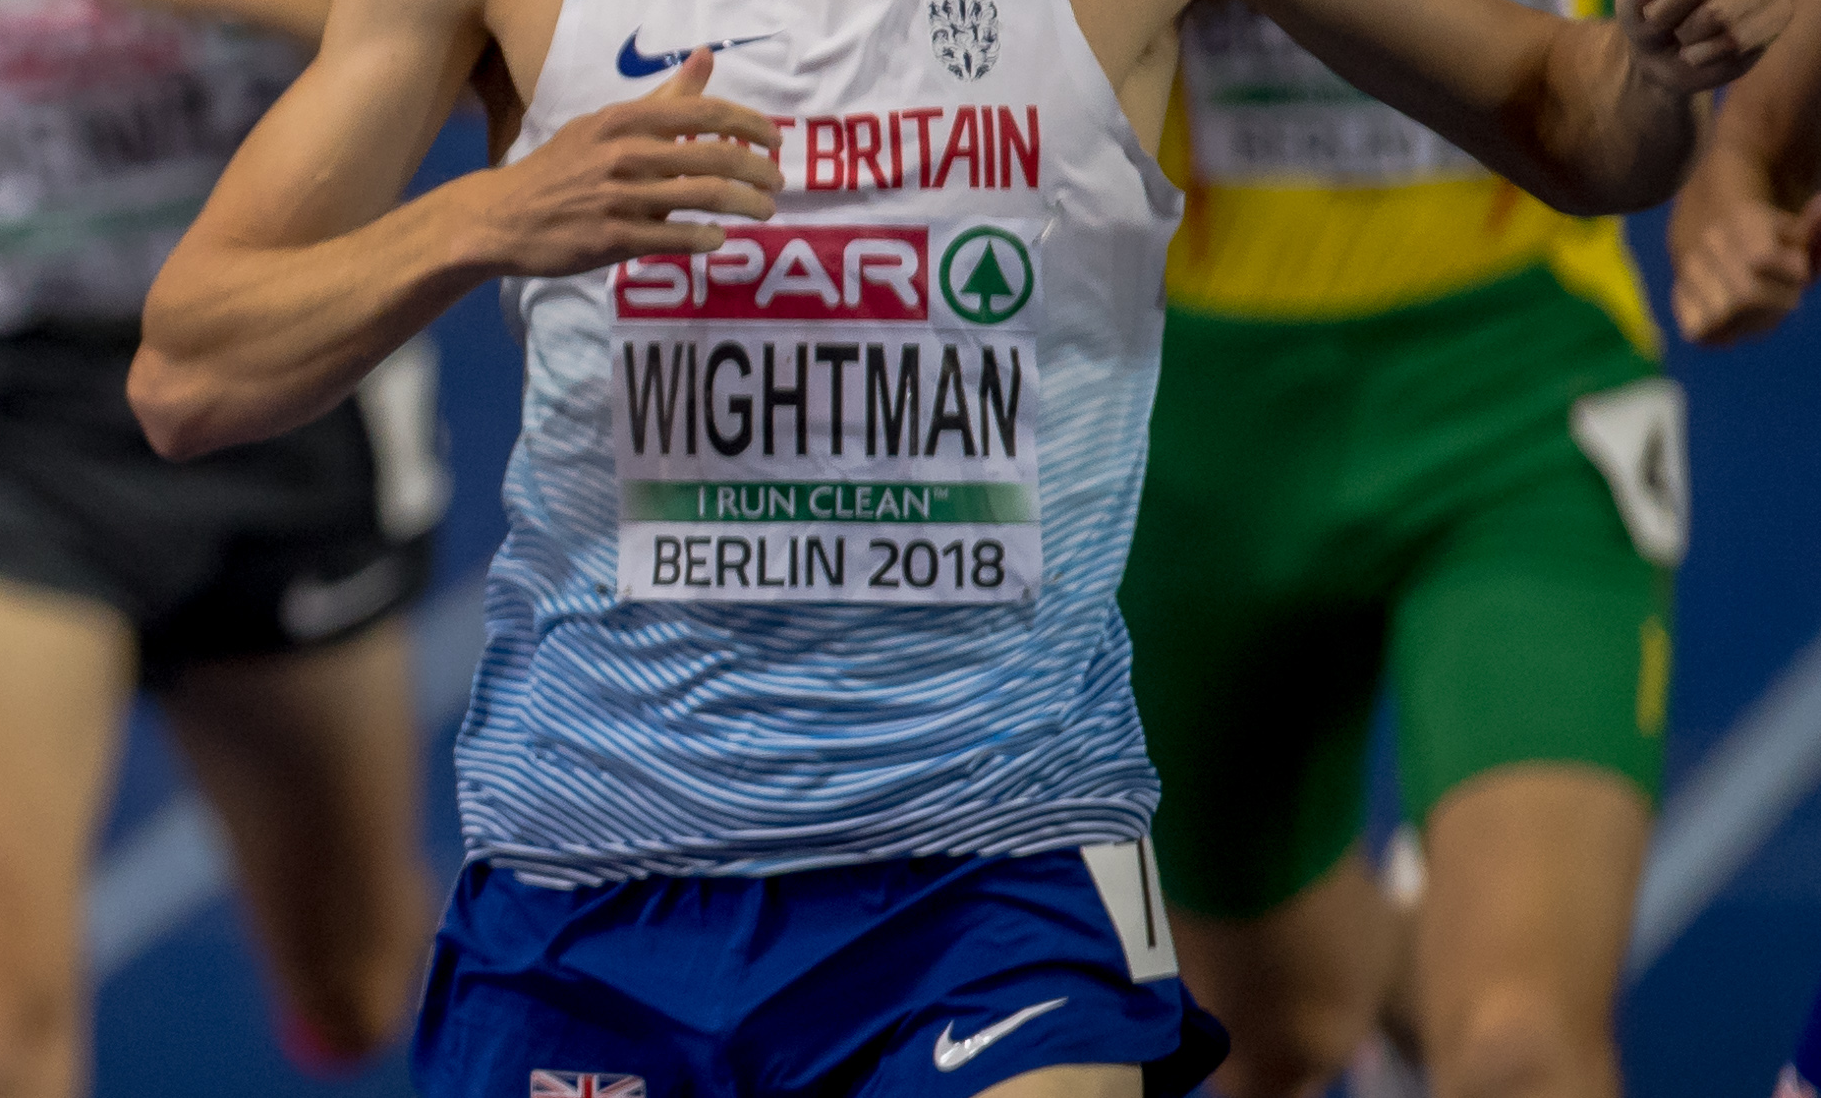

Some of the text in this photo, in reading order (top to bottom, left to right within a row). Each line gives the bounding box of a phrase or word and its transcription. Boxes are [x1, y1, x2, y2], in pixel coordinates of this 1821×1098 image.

[806, 105, 1040, 192] BRITAIN
[623, 238, 919, 310] SPAR
[624, 340, 1021, 458] WIGHTMAN
[698, 486, 705, 517] I
[717, 486, 794, 518] RUN
[652, 534, 1005, 589] BERLIN 2018
